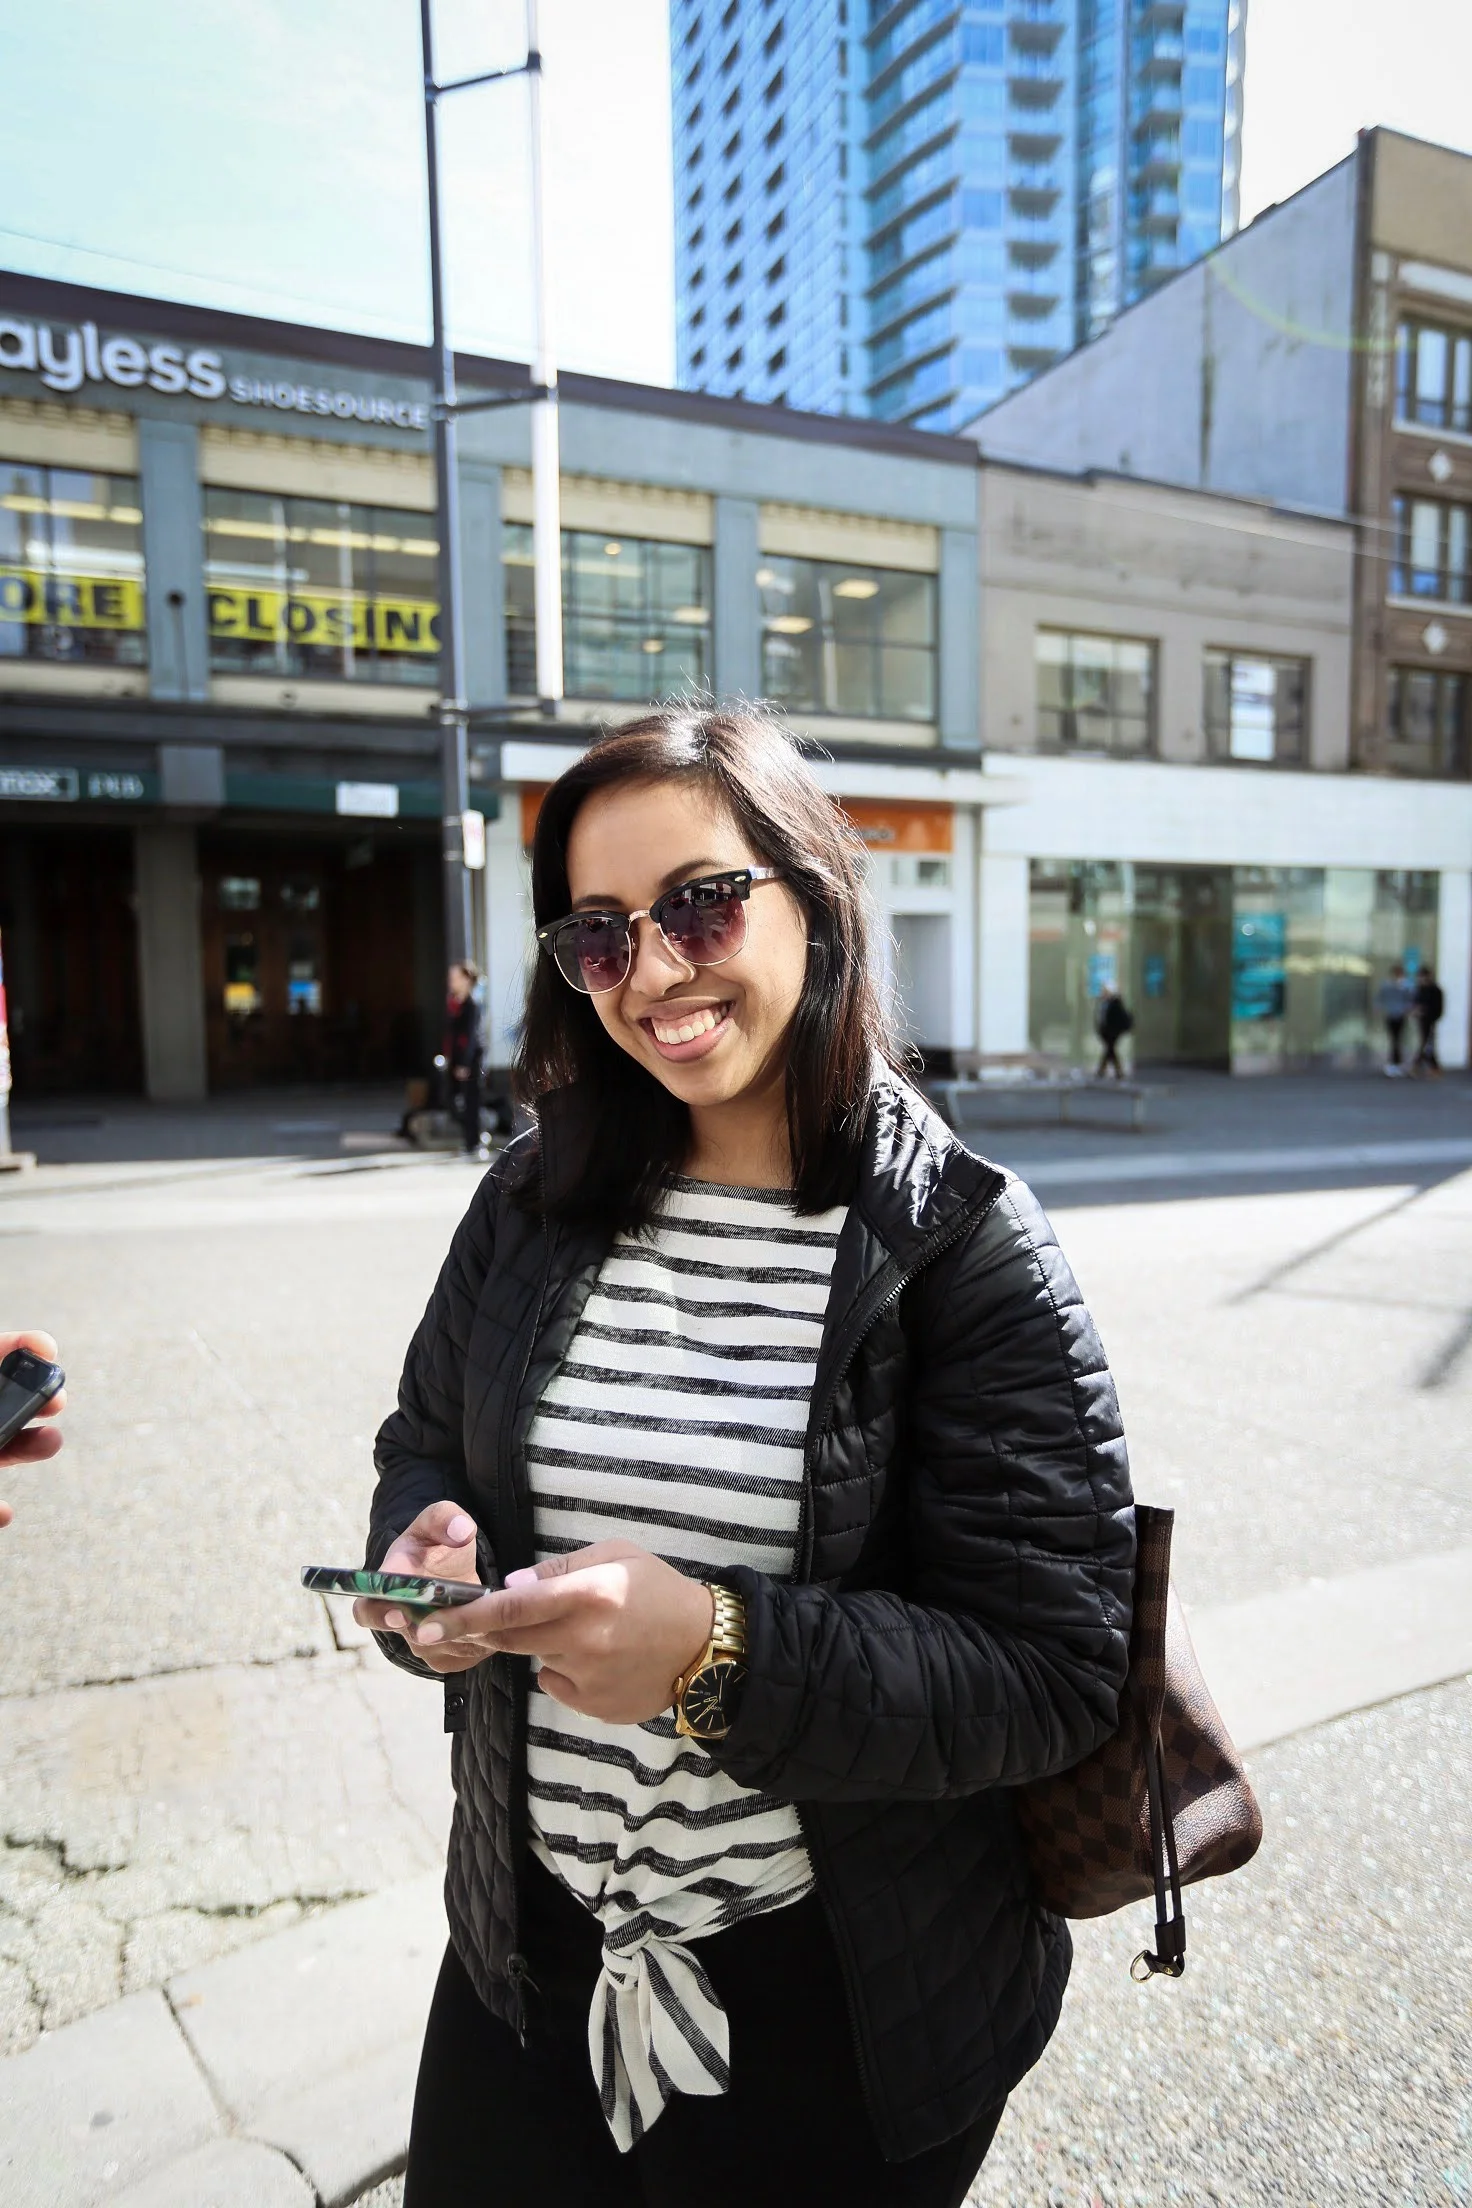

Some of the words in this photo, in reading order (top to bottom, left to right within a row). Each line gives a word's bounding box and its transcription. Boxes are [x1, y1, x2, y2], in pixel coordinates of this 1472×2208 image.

[0, 319, 227, 399] ayless
[228, 375, 428, 430] SHOESOURCE
[0, 576, 125, 618] ORE
